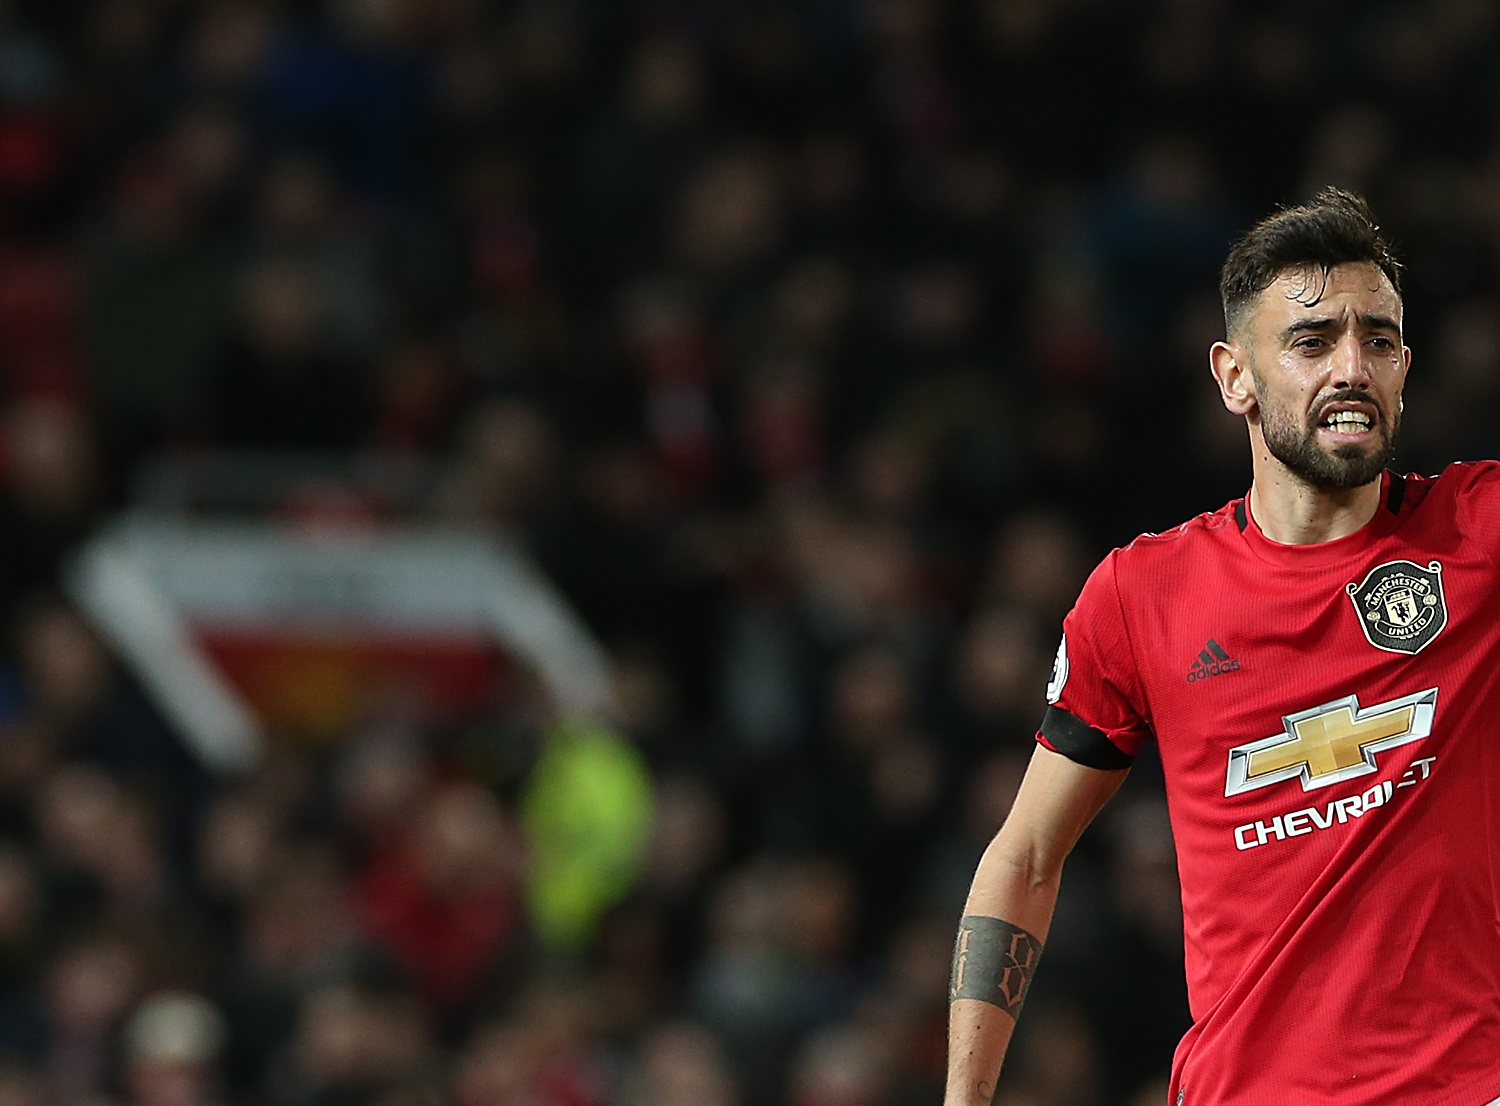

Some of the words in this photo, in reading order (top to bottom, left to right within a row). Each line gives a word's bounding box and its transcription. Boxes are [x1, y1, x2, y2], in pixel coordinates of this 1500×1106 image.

[1371, 578, 1426, 606] MANCHESTER
[1388, 618, 1427, 636] UNITED
[1187, 660, 1240, 682] adidas
